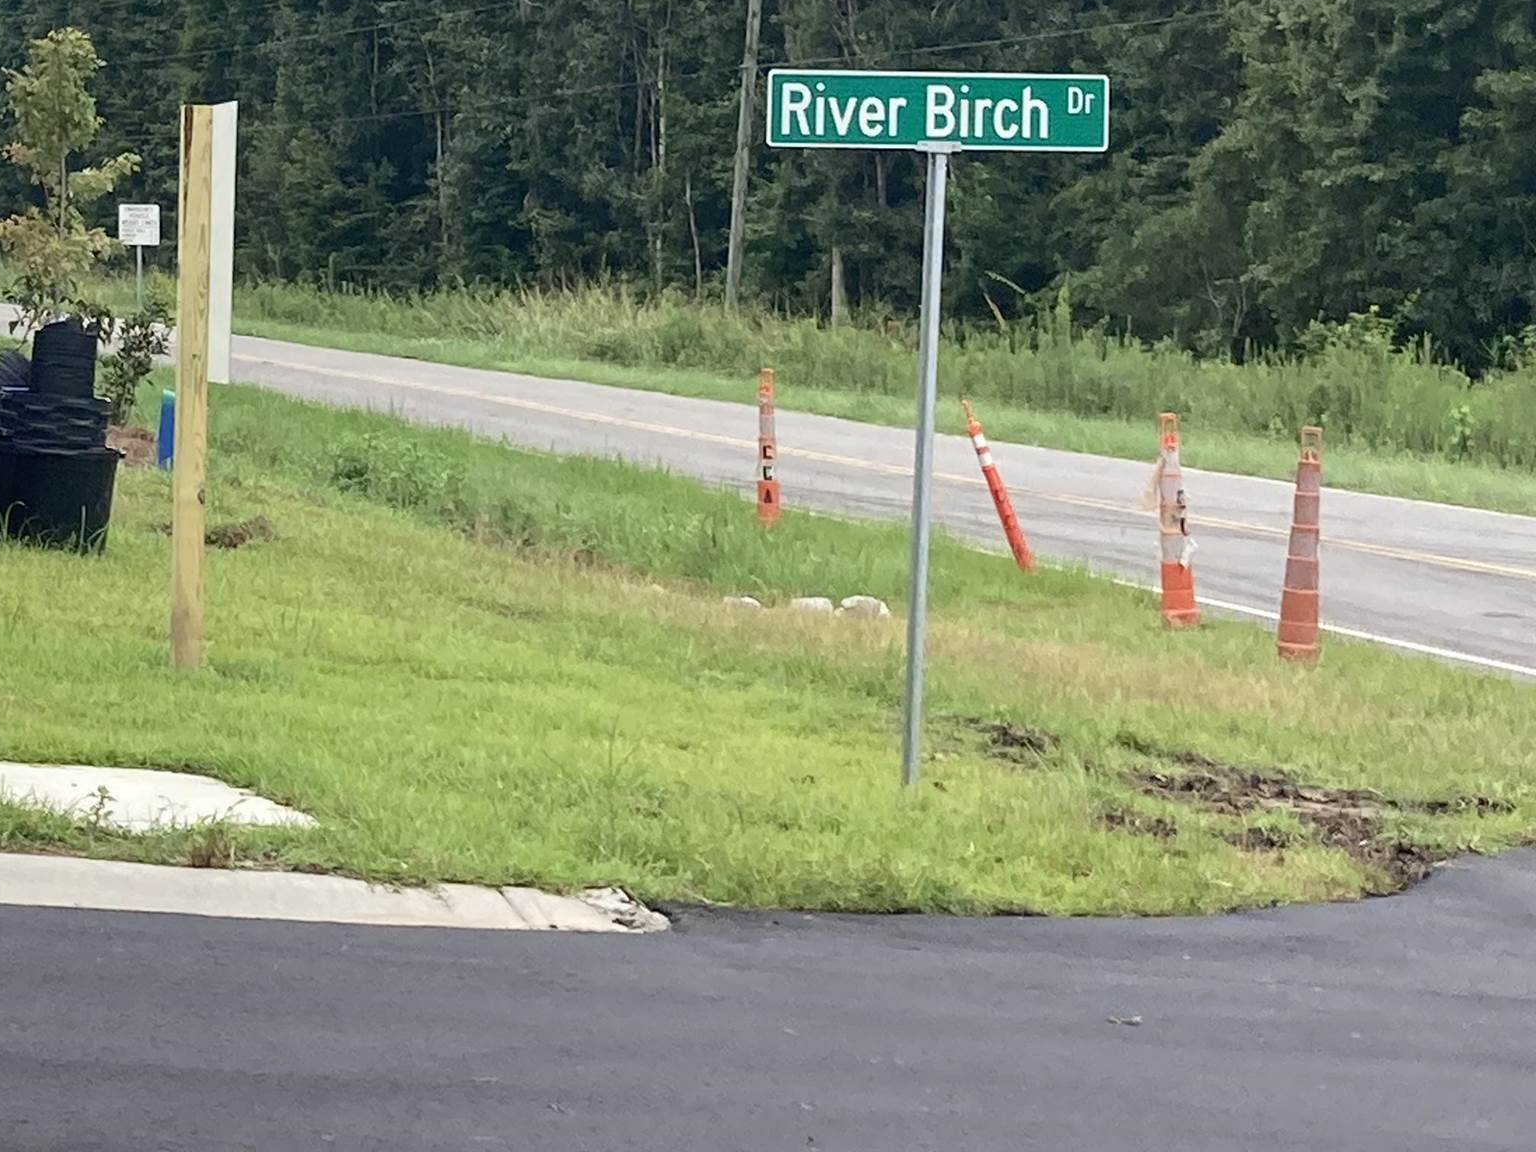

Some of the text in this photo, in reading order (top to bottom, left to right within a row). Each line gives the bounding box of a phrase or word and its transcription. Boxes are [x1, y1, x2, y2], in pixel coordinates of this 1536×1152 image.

[780, 83, 1095, 138] River Birch Dr
